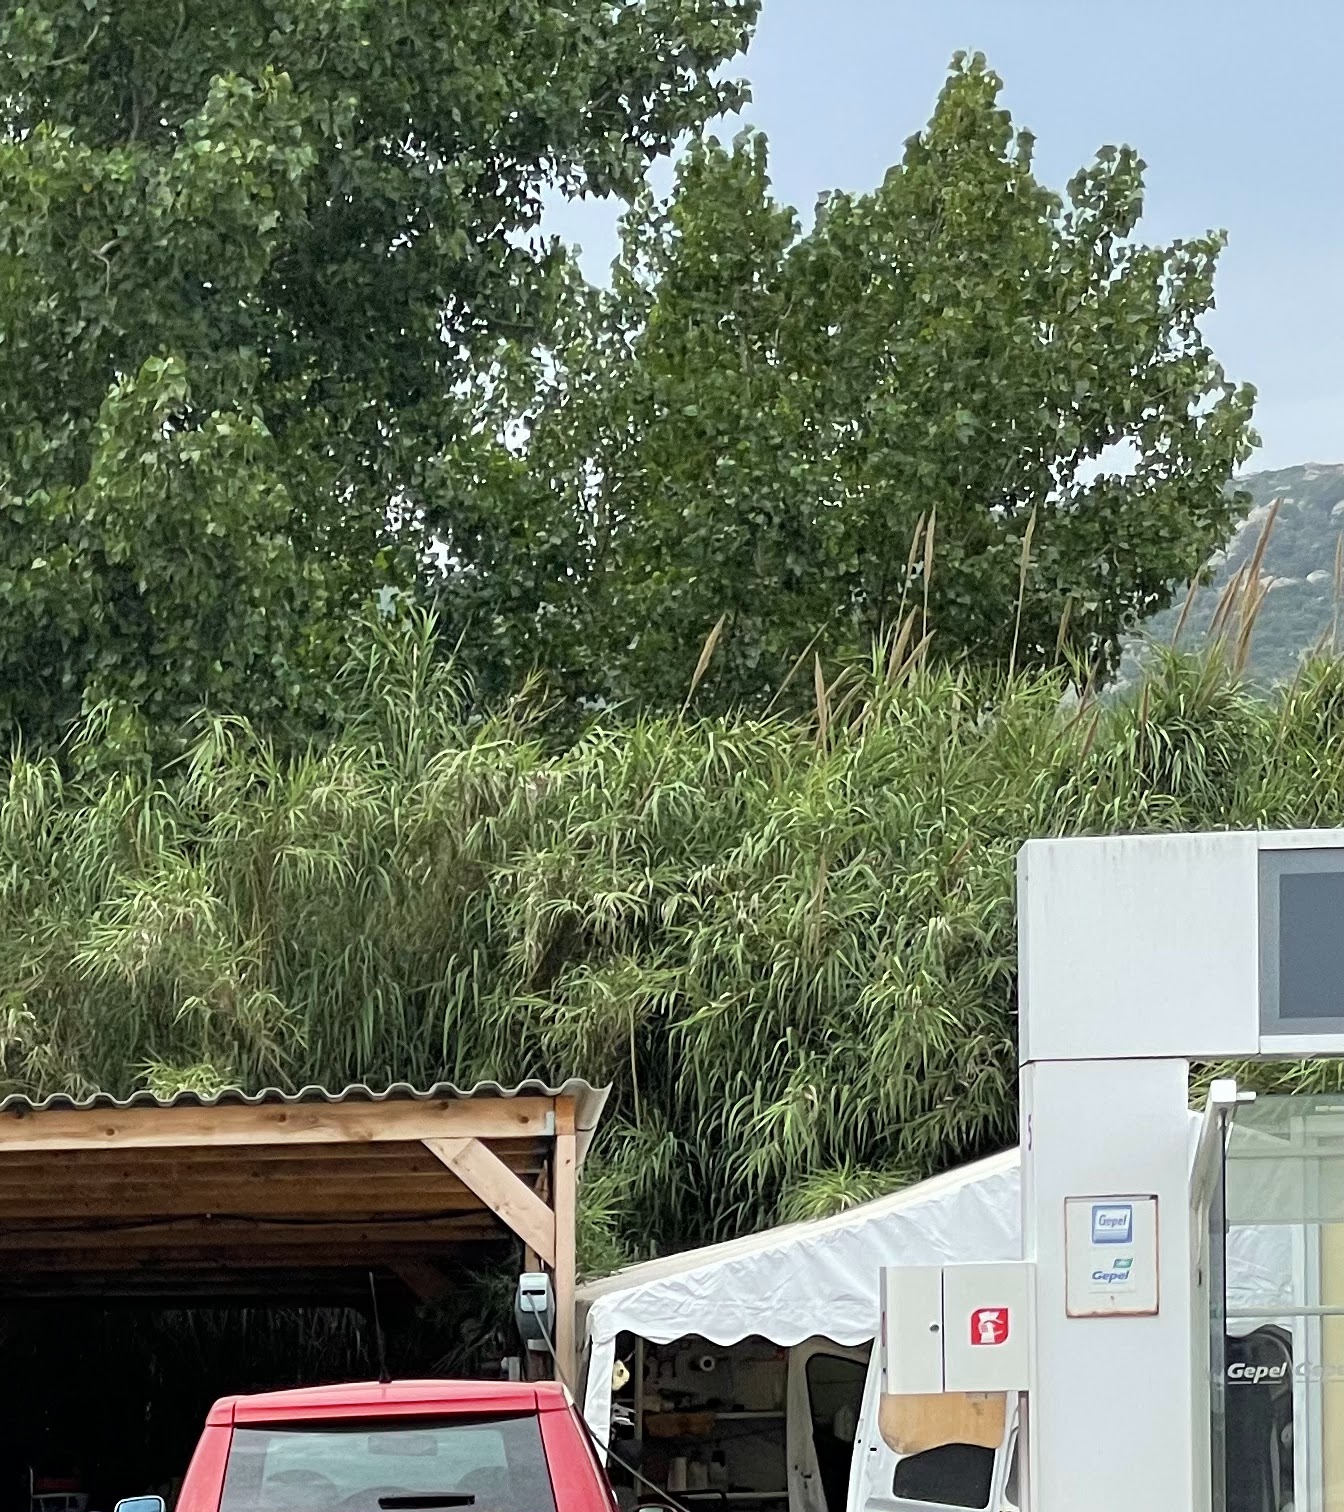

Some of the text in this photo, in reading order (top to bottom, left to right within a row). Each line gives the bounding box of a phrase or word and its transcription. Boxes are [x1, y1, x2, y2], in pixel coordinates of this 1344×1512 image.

[1098, 1214, 1127, 1228] Gepel
[1092, 1270, 1130, 1284] Gepel
[1227, 1362, 1288, 1384] Gepel
